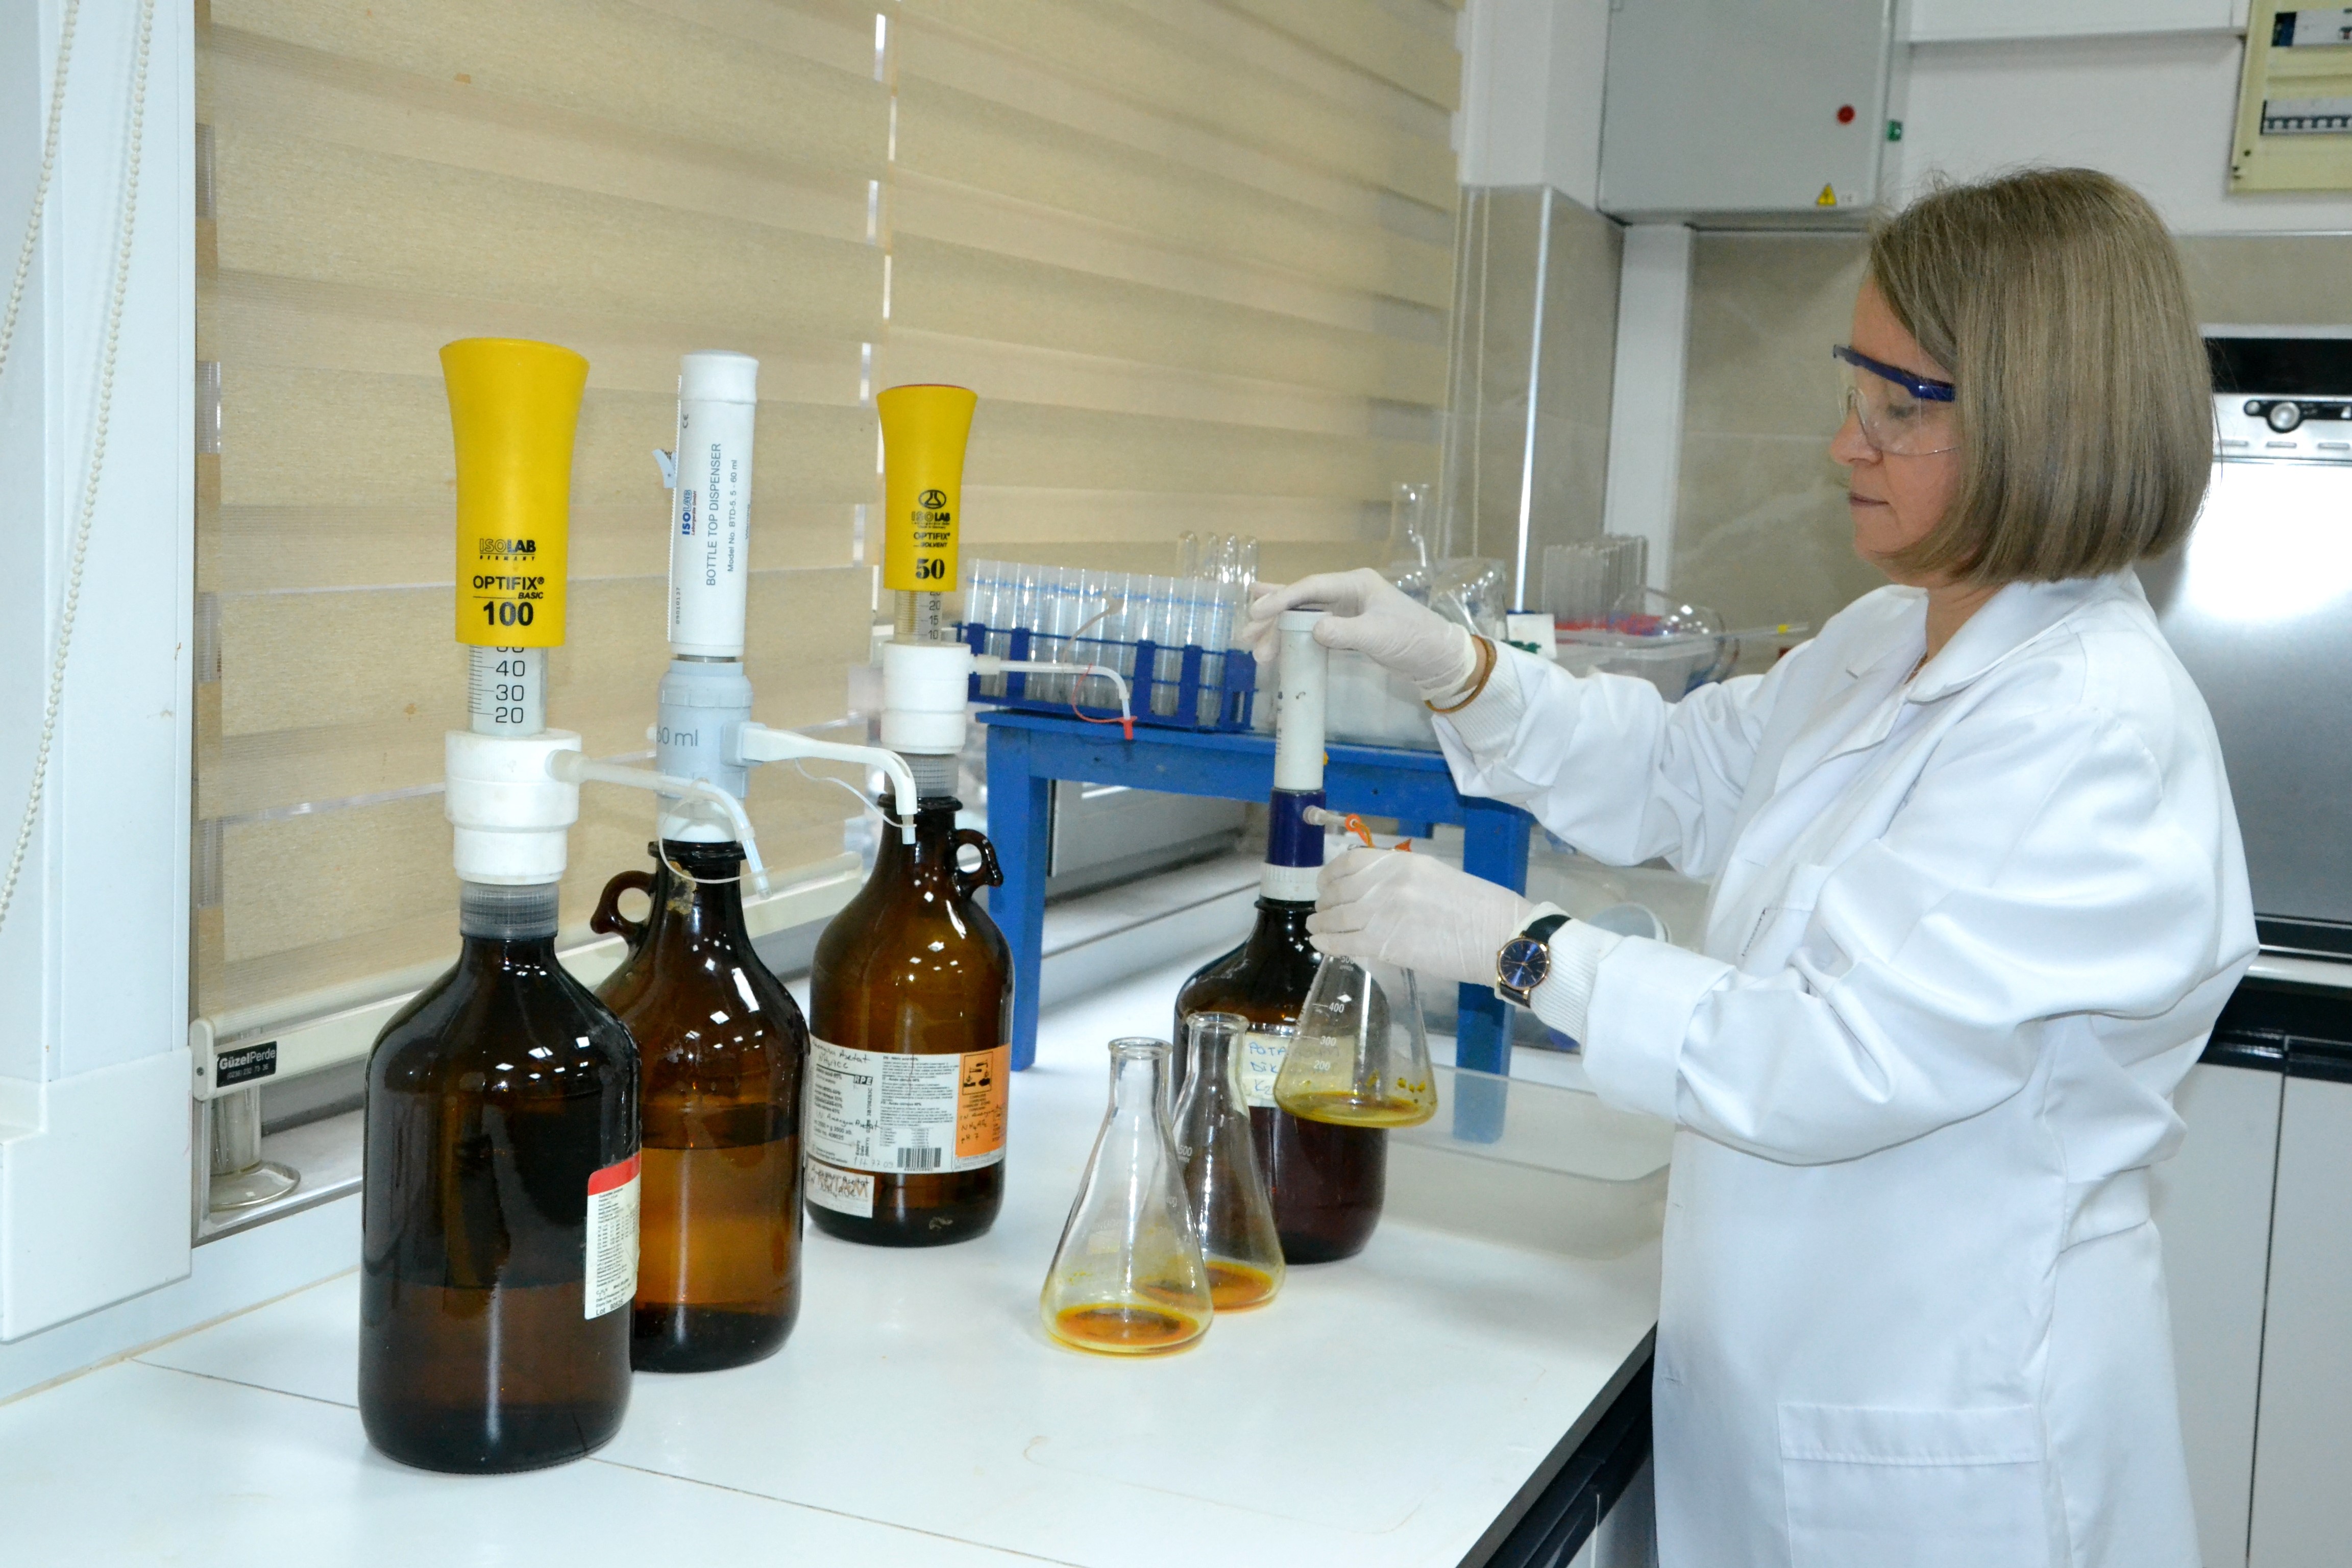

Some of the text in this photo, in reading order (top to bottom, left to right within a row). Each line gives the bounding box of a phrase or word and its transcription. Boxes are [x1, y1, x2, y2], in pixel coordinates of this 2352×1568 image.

[682, 489, 693, 535] ISOLAB
[706, 443, 721, 586] BOTTLE TOP DISPENSER
[911, 511, 950, 522] ISOLAB
[479, 538, 536, 553] ISOLAB
[727, 547, 736, 572] Model
[915, 558, 945, 579] 50
[929, 600, 941, 610] 20
[483, 601, 534, 626] 100
[929, 615, 939, 625] 15
[928, 629, 939, 640] 10
[495, 660, 525, 677] 40
[496, 684, 524, 701] 30
[495, 707, 524, 724] 20
[675, 728, 698, 746] ml
[1329, 1002, 1344, 1013] 400
[1320, 1036, 1337, 1046] 300
[219, 1048, 276, 1070] GüzelPerde
[1313, 1060, 1331, 1071] 200
[853, 1074, 873, 1086] RPE
[1178, 1145, 1192, 1157] 500
[596, 1307, 605, 1316] Lot
